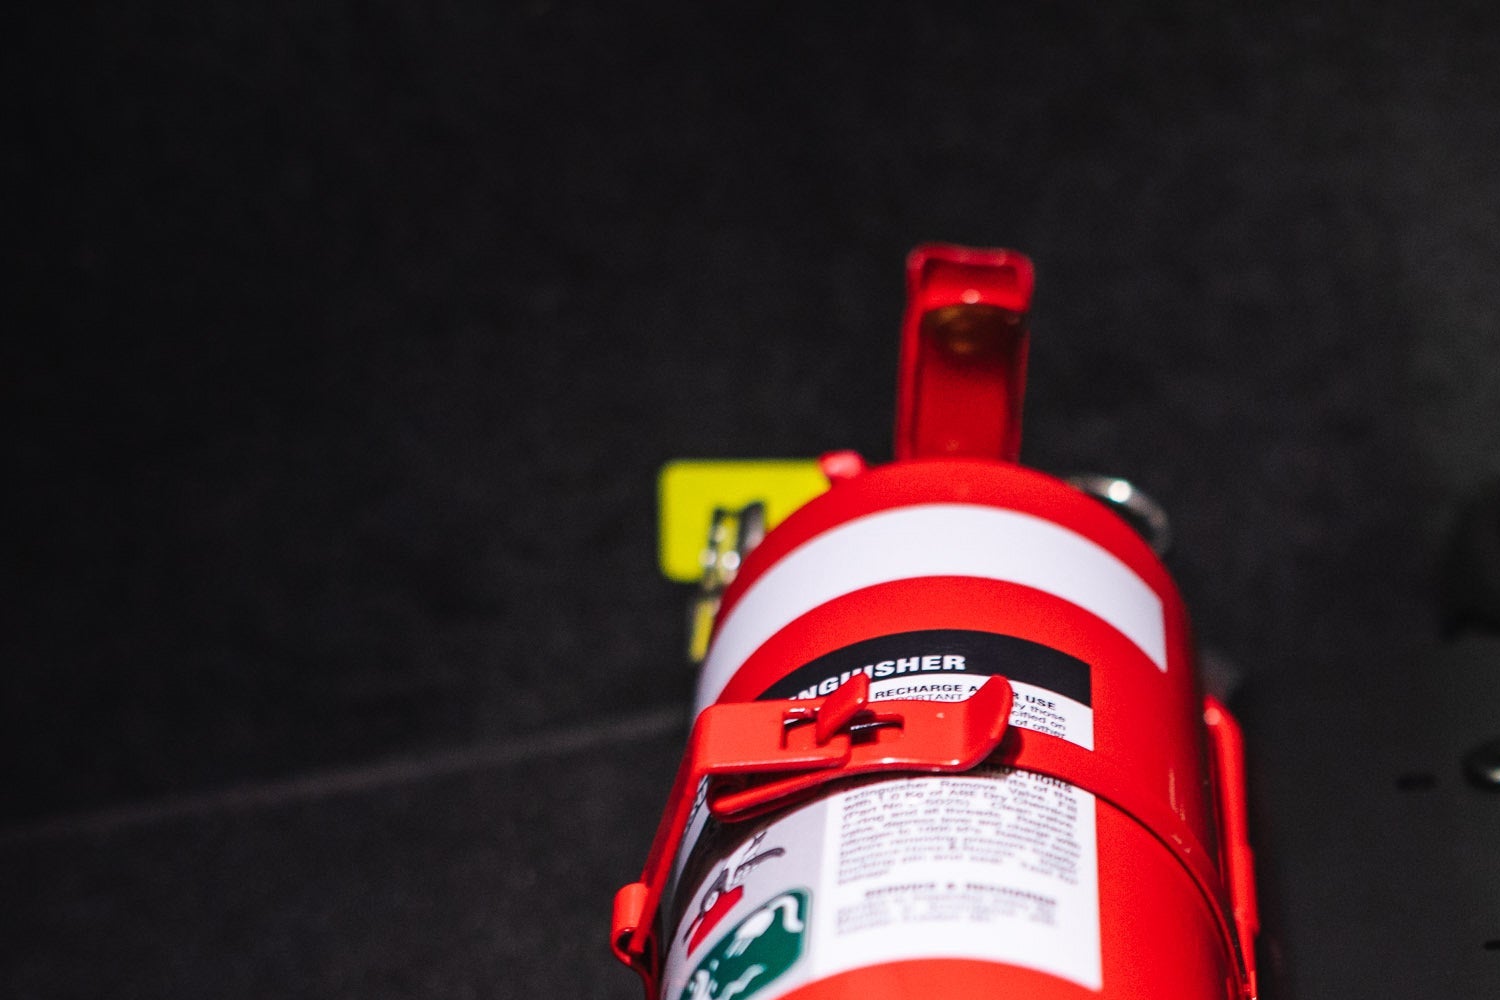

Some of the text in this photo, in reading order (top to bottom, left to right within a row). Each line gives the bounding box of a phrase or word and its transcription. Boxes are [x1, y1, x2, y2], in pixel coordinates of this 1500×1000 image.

[788, 654, 967, 700] NGISHER
[874, 684, 963, 699] RECHARGE
[1025, 694, 1056, 711] USE
